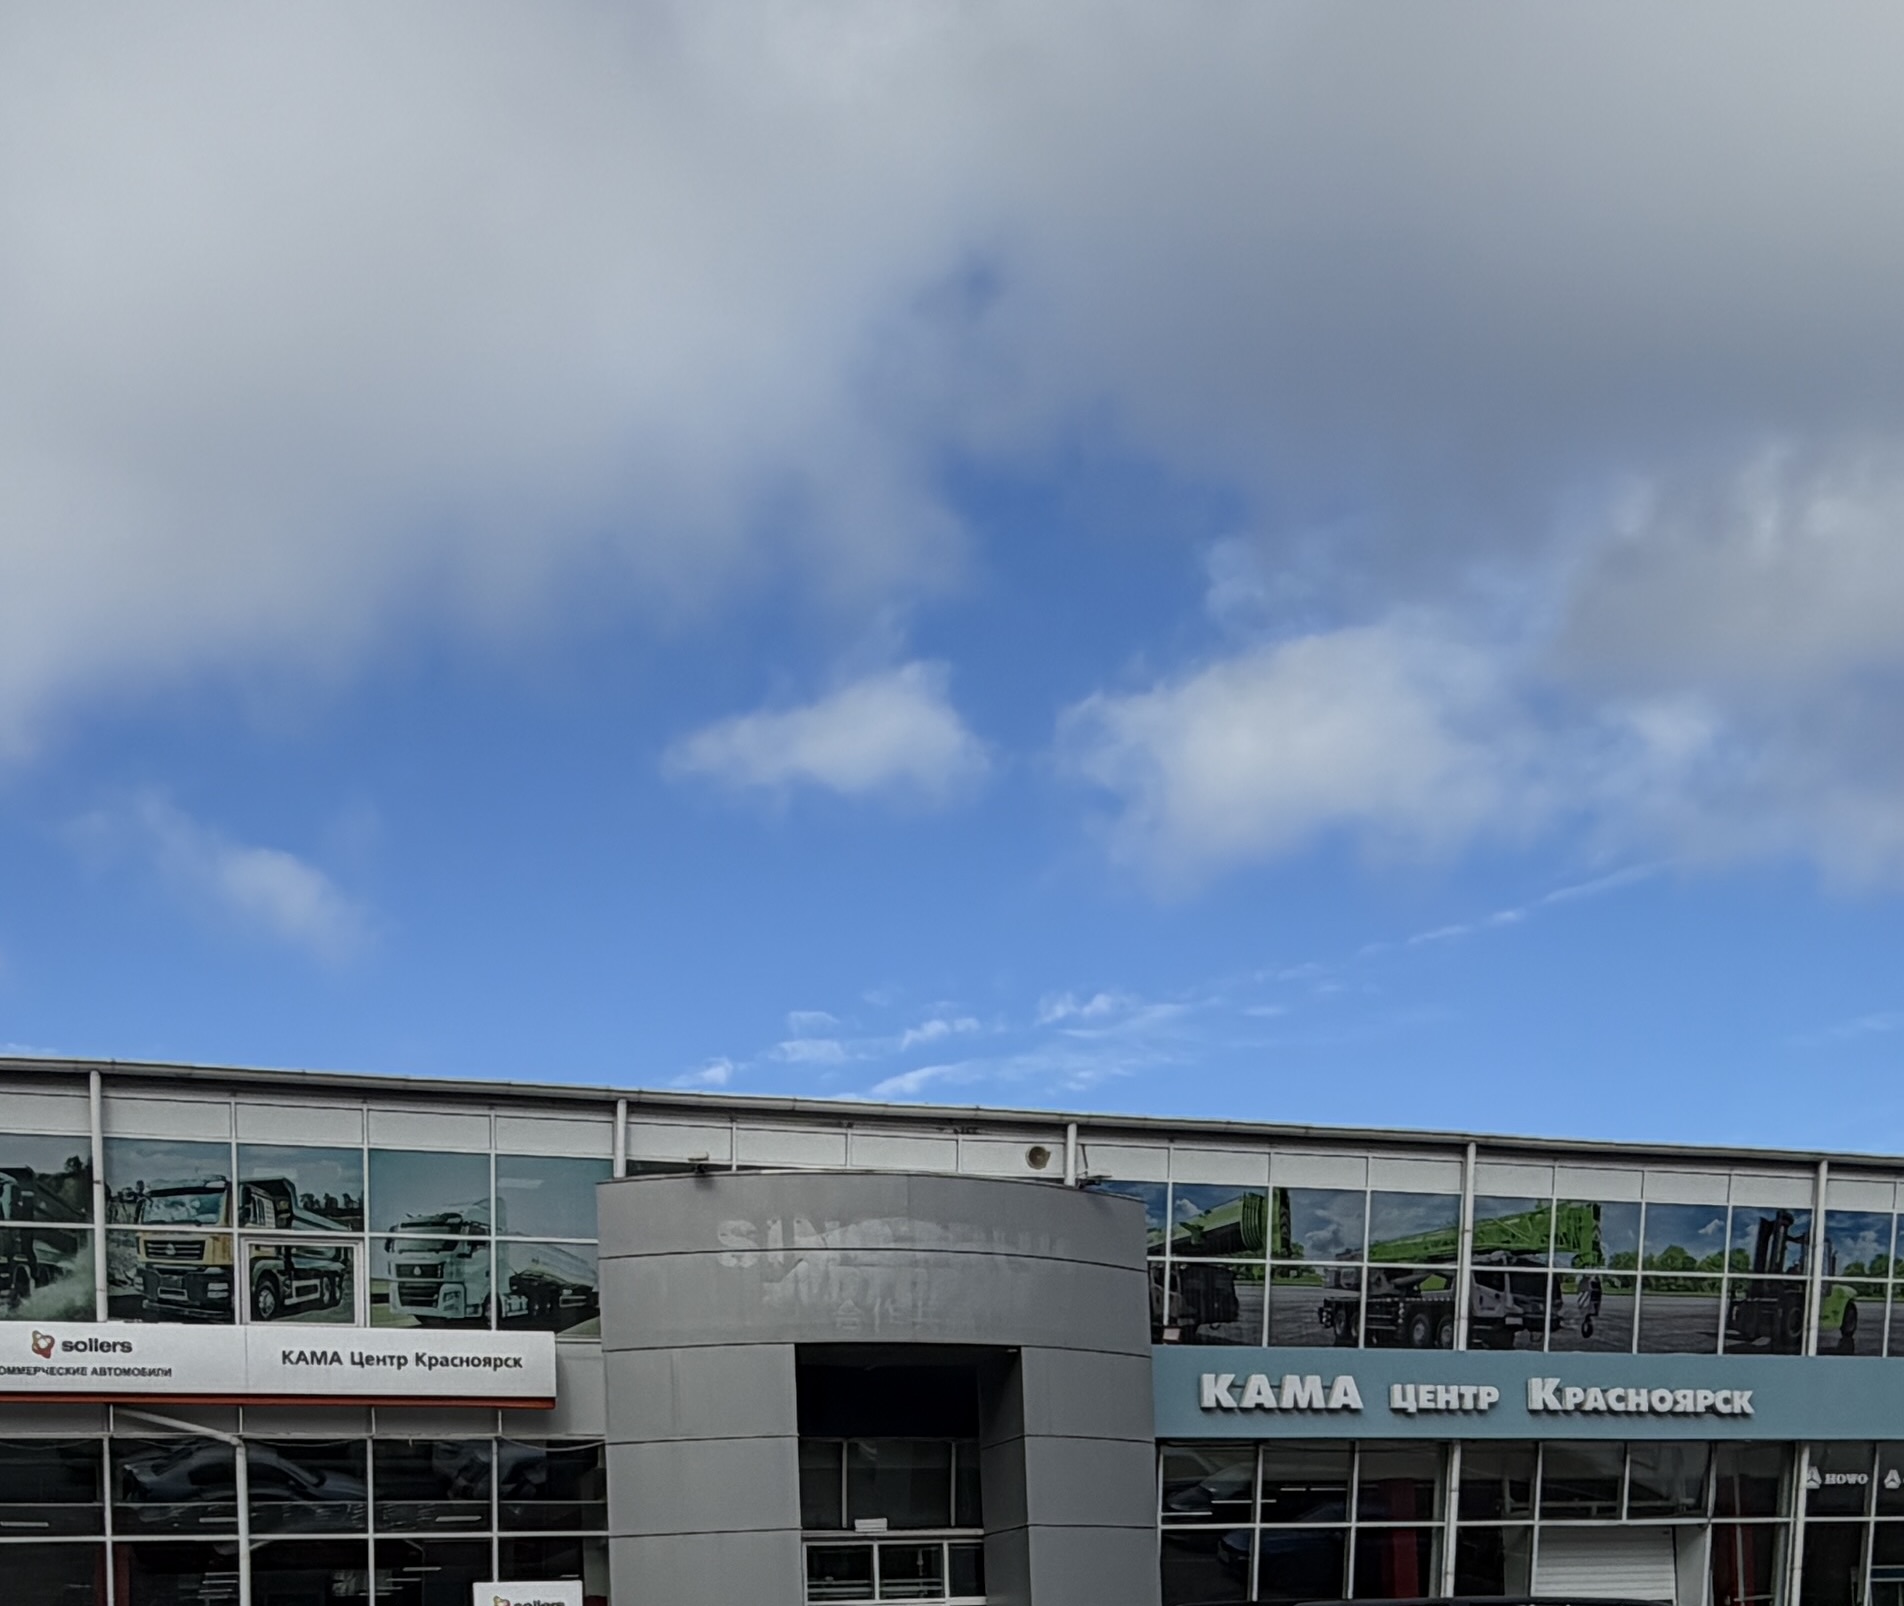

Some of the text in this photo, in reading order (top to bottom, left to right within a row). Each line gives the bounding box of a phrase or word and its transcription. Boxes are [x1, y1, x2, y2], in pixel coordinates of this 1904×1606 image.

[61, 1338, 133, 1353] sollers
[282, 1350, 523, 1371] КАМА Центр Красноярск
[91, 1366, 172, 1377] АВТОМОБИЛИ
[1200, 1374, 1363, 1409] КАМА
